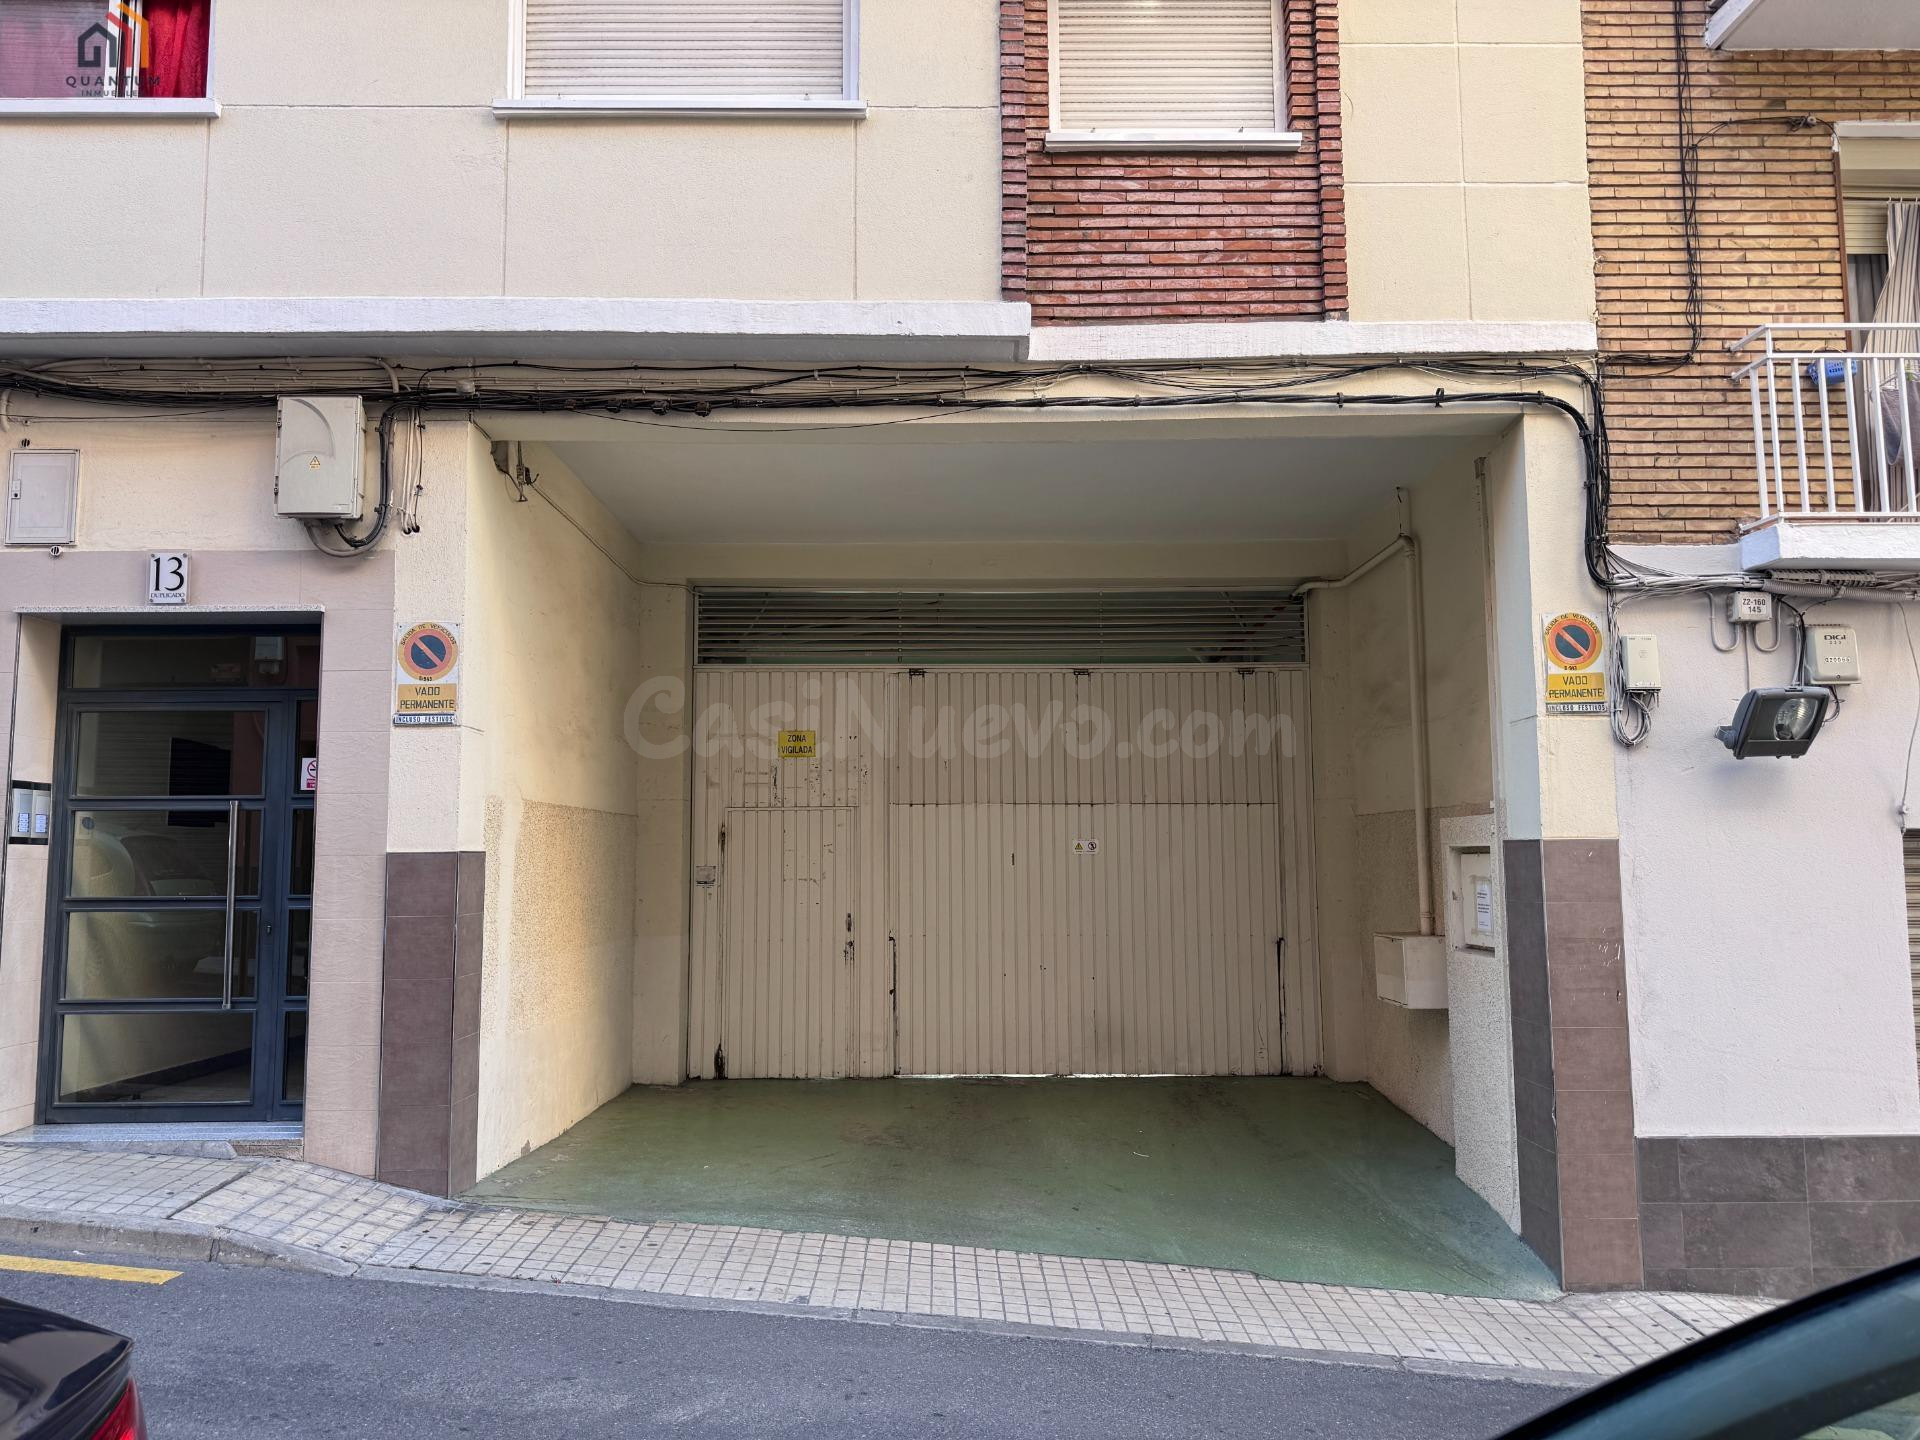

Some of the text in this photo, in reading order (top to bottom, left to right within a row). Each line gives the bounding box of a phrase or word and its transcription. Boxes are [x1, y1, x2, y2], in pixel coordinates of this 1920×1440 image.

[153, 556, 185, 591] 13
[1742, 598, 1766, 606] Z2-160
[1545, 618, 1559, 635] SALIDA
[401, 628, 416, 645] SALIDA
[1562, 675, 1588, 685] VADO
[415, 686, 441, 696] VADO
[1549, 687, 1604, 698] PERMANENTE
[400, 699, 455, 709] PERMANENTE
[787, 734, 806, 742] ZONA
[781, 746, 813, 754] VIGILADA
